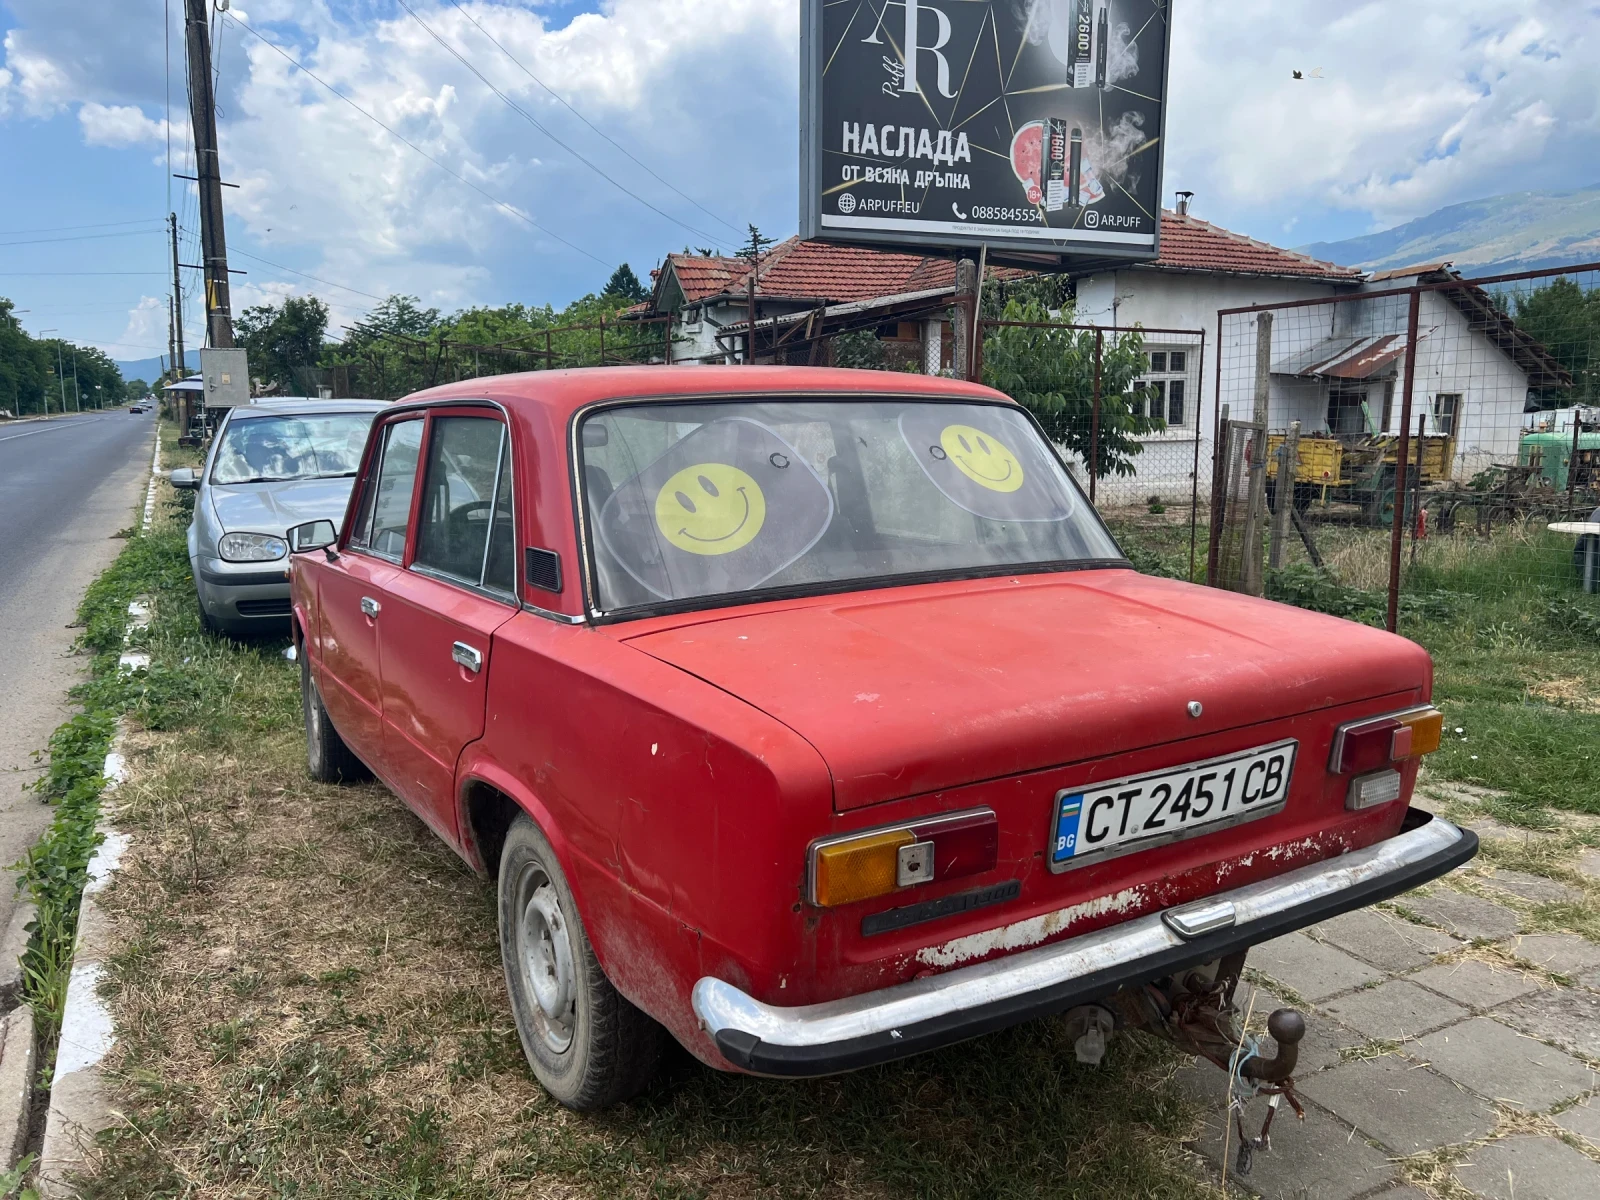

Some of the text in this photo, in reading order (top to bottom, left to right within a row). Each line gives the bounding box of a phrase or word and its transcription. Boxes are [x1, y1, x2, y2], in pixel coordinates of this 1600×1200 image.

[1078, 14, 1090, 50] 2600
[882, 56, 905, 98] Puff
[842, 121, 971, 167] НАСЛАДА
[1051, 134, 1064, 160] 1600
[841, 165, 971, 190] ОТ ВСЯКА ДРЪПКА
[1028, 190, 1041, 199] 18+
[858, 198, 920, 214] ARPUFF.EU
[971, 205, 1043, 222] 0885845554
[1100, 214, 1141, 228] AR.PUFF
[1057, 833, 1075, 851] BG
